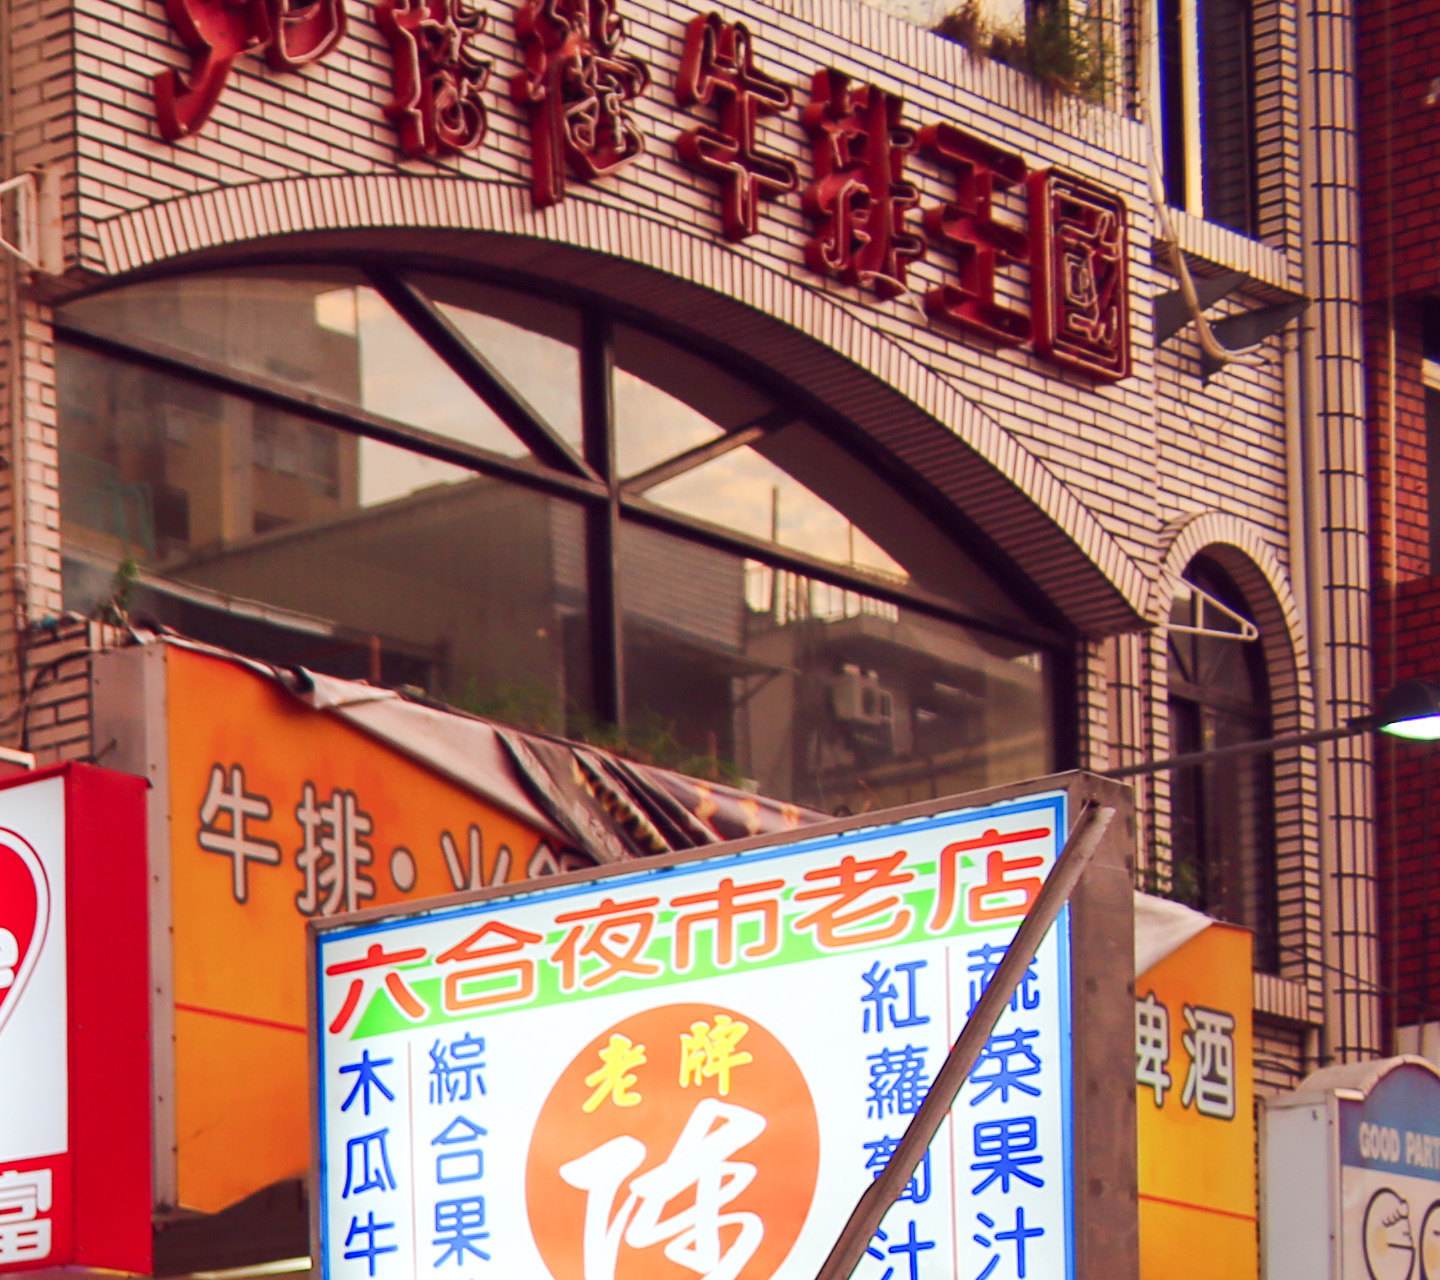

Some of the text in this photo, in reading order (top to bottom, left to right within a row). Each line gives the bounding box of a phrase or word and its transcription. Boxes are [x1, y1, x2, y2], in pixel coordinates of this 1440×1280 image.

[326, 826, 1054, 1036] 六合夜市老店
[582, 1016, 753, 1115] 老牌
[1359, 1121, 1401, 1163] GOOD
